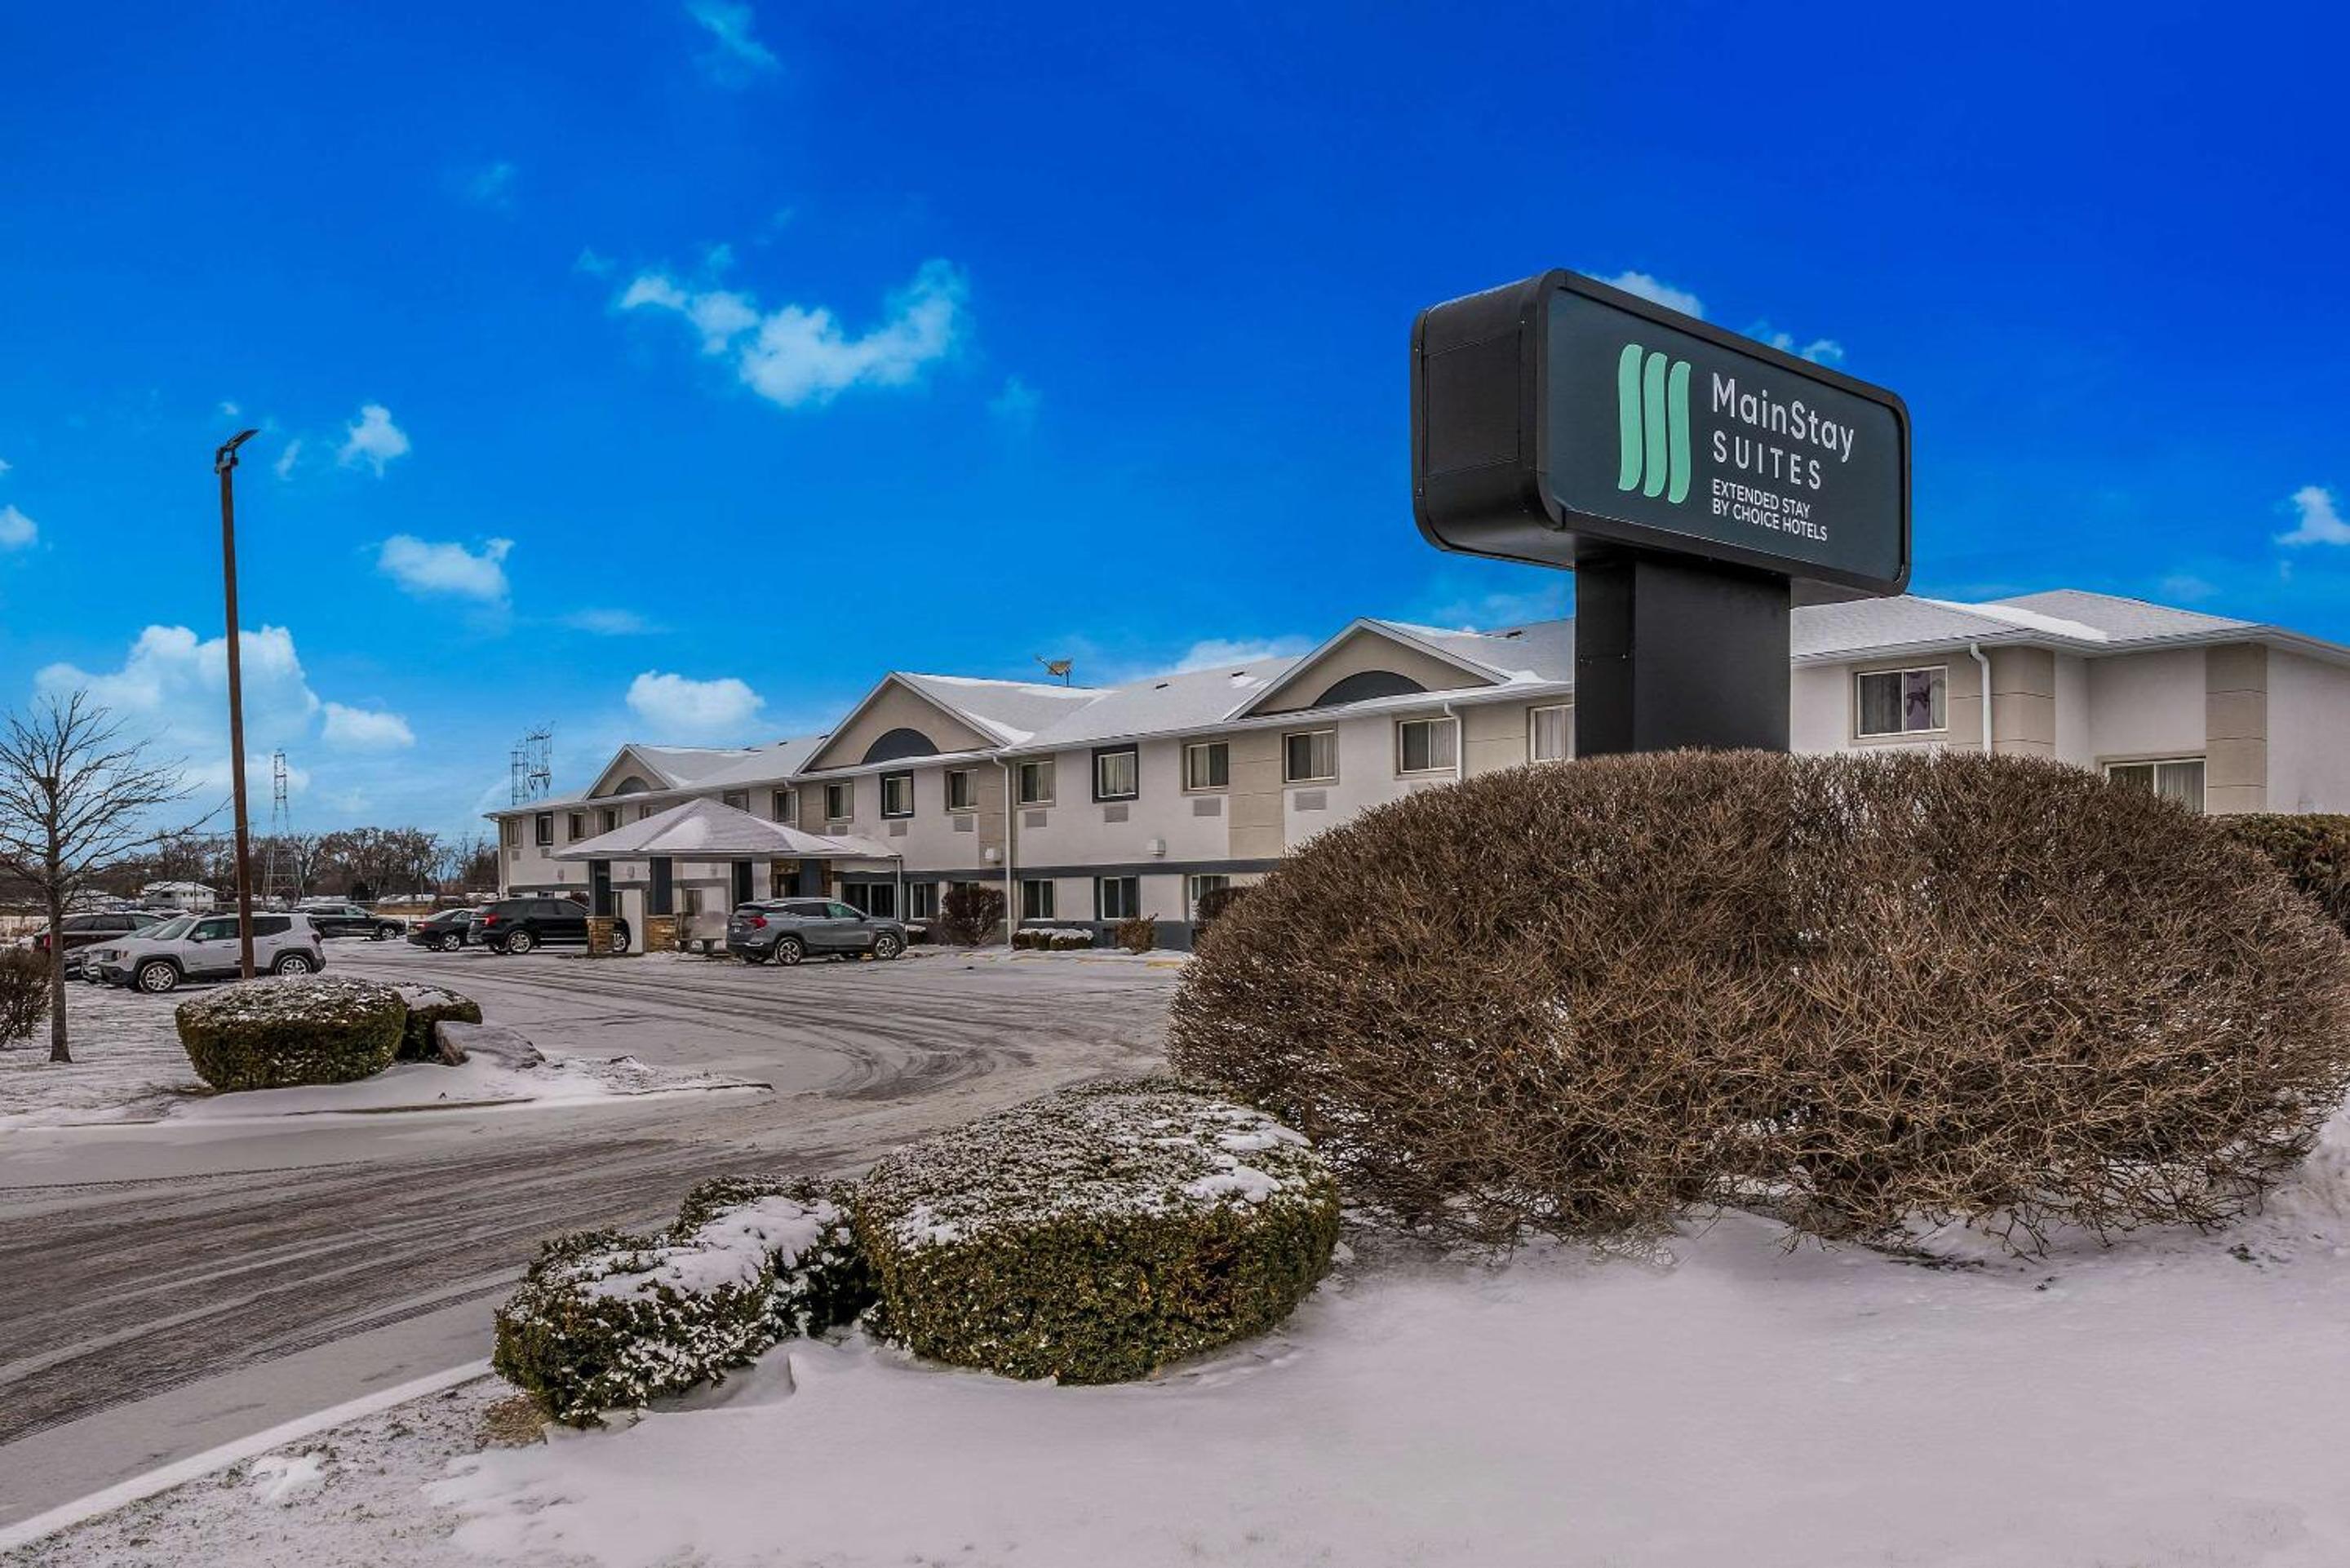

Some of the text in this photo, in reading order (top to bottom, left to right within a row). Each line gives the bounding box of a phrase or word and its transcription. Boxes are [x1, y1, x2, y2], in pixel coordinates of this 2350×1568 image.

[1713, 372, 1855, 463] MainStay
[1713, 430, 1822, 489] SUITES
[1713, 478, 1811, 519] EXTENDED STAY
[1713, 498, 1828, 542] BY CHOICE HOTELS
